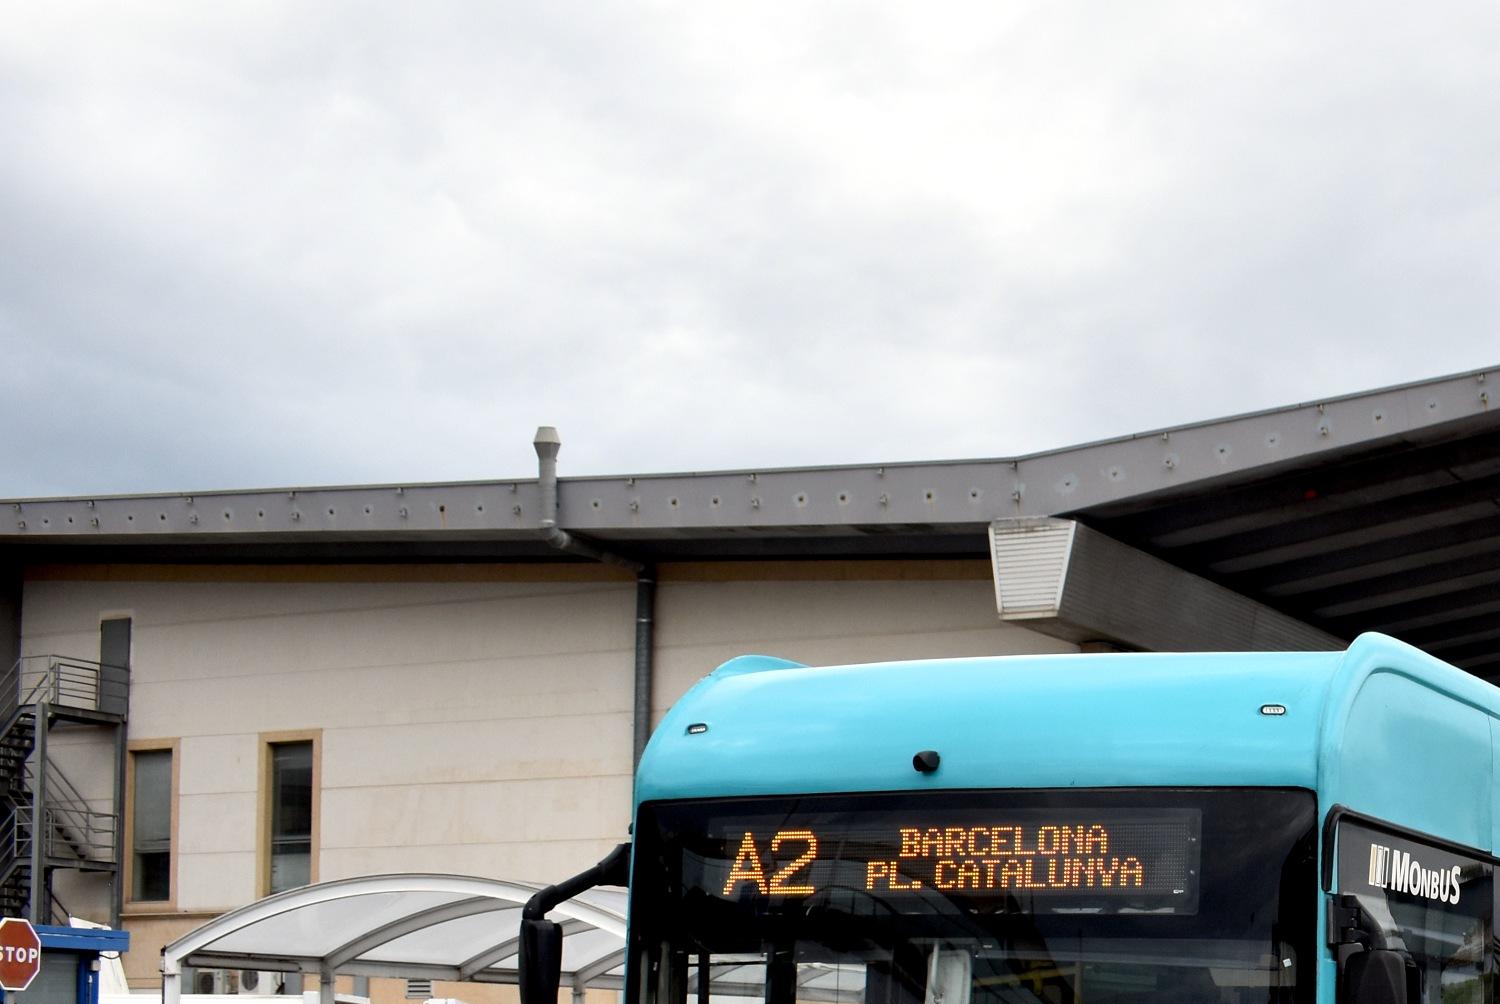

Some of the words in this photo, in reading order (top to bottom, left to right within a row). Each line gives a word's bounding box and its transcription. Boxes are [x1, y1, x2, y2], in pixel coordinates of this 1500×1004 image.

[723, 830, 817, 895] A2
[899, 825, 1108, 857] BARCELONA
[866, 860, 921, 890] PL.
[934, 857, 1143, 889] CATALUNYA
[1390, 849, 1461, 904] MONBUS
